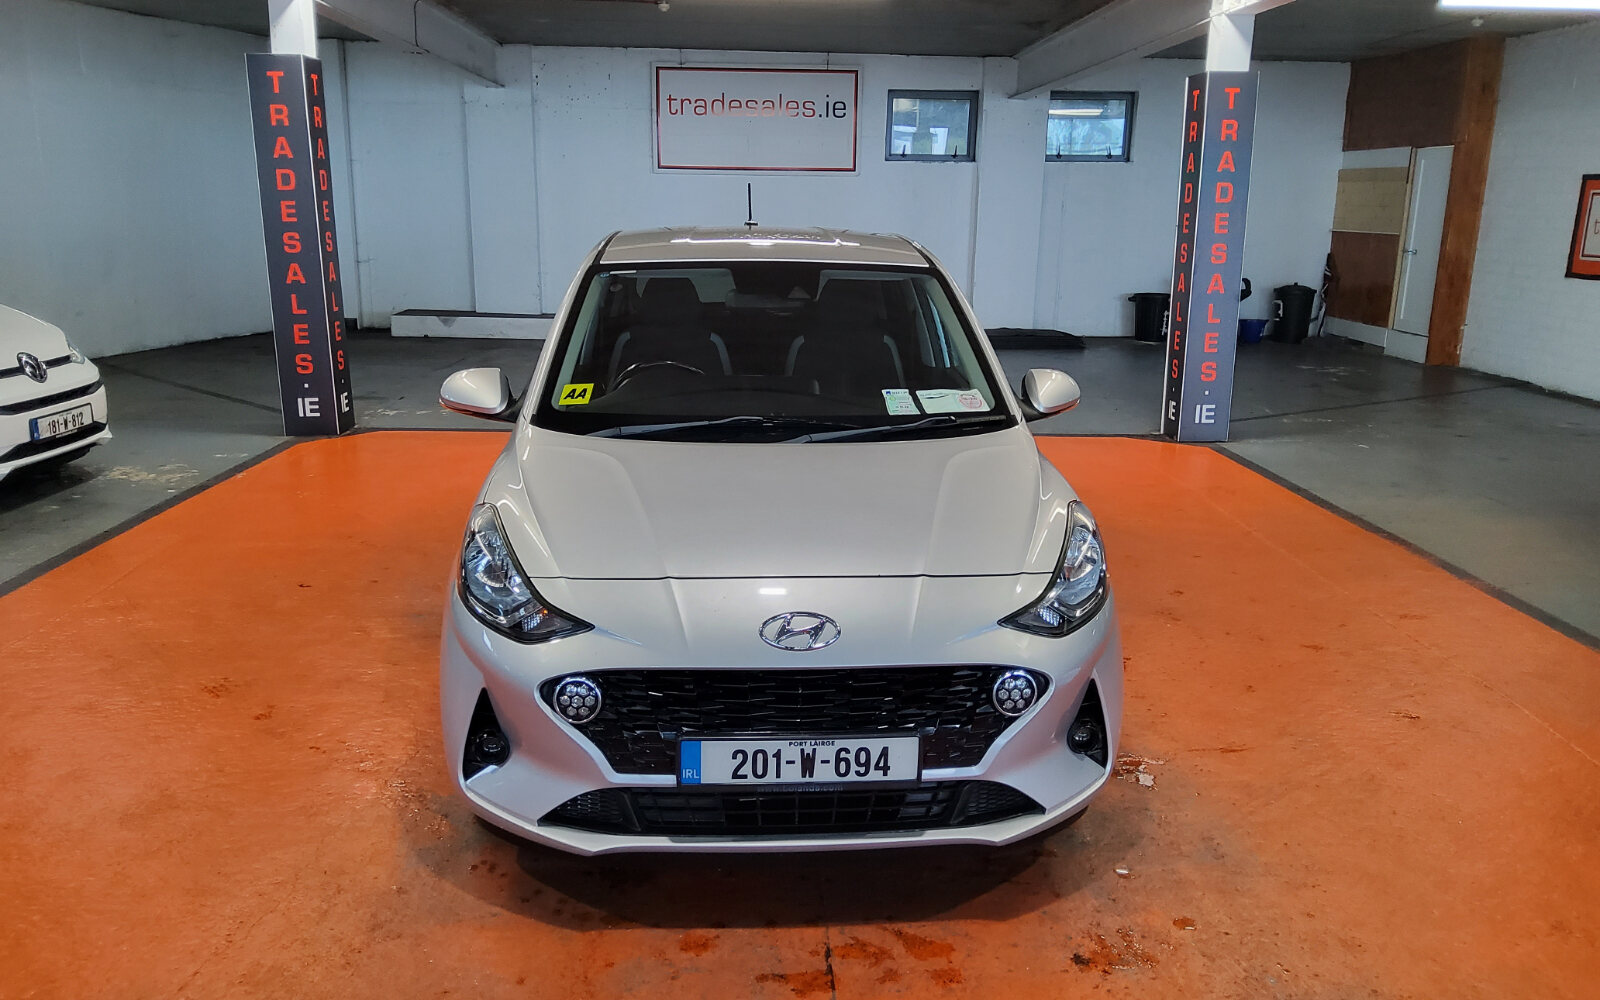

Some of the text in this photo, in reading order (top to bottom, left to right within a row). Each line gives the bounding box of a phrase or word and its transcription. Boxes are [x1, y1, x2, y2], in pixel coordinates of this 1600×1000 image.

[666, 92, 847, 118] tradesales.ie
[563, 388, 588, 400] AA
[47, 412, 84, 435] 181-W-812
[682, 769, 700, 779] IRL
[731, 746, 891, 780] 201-W-694
